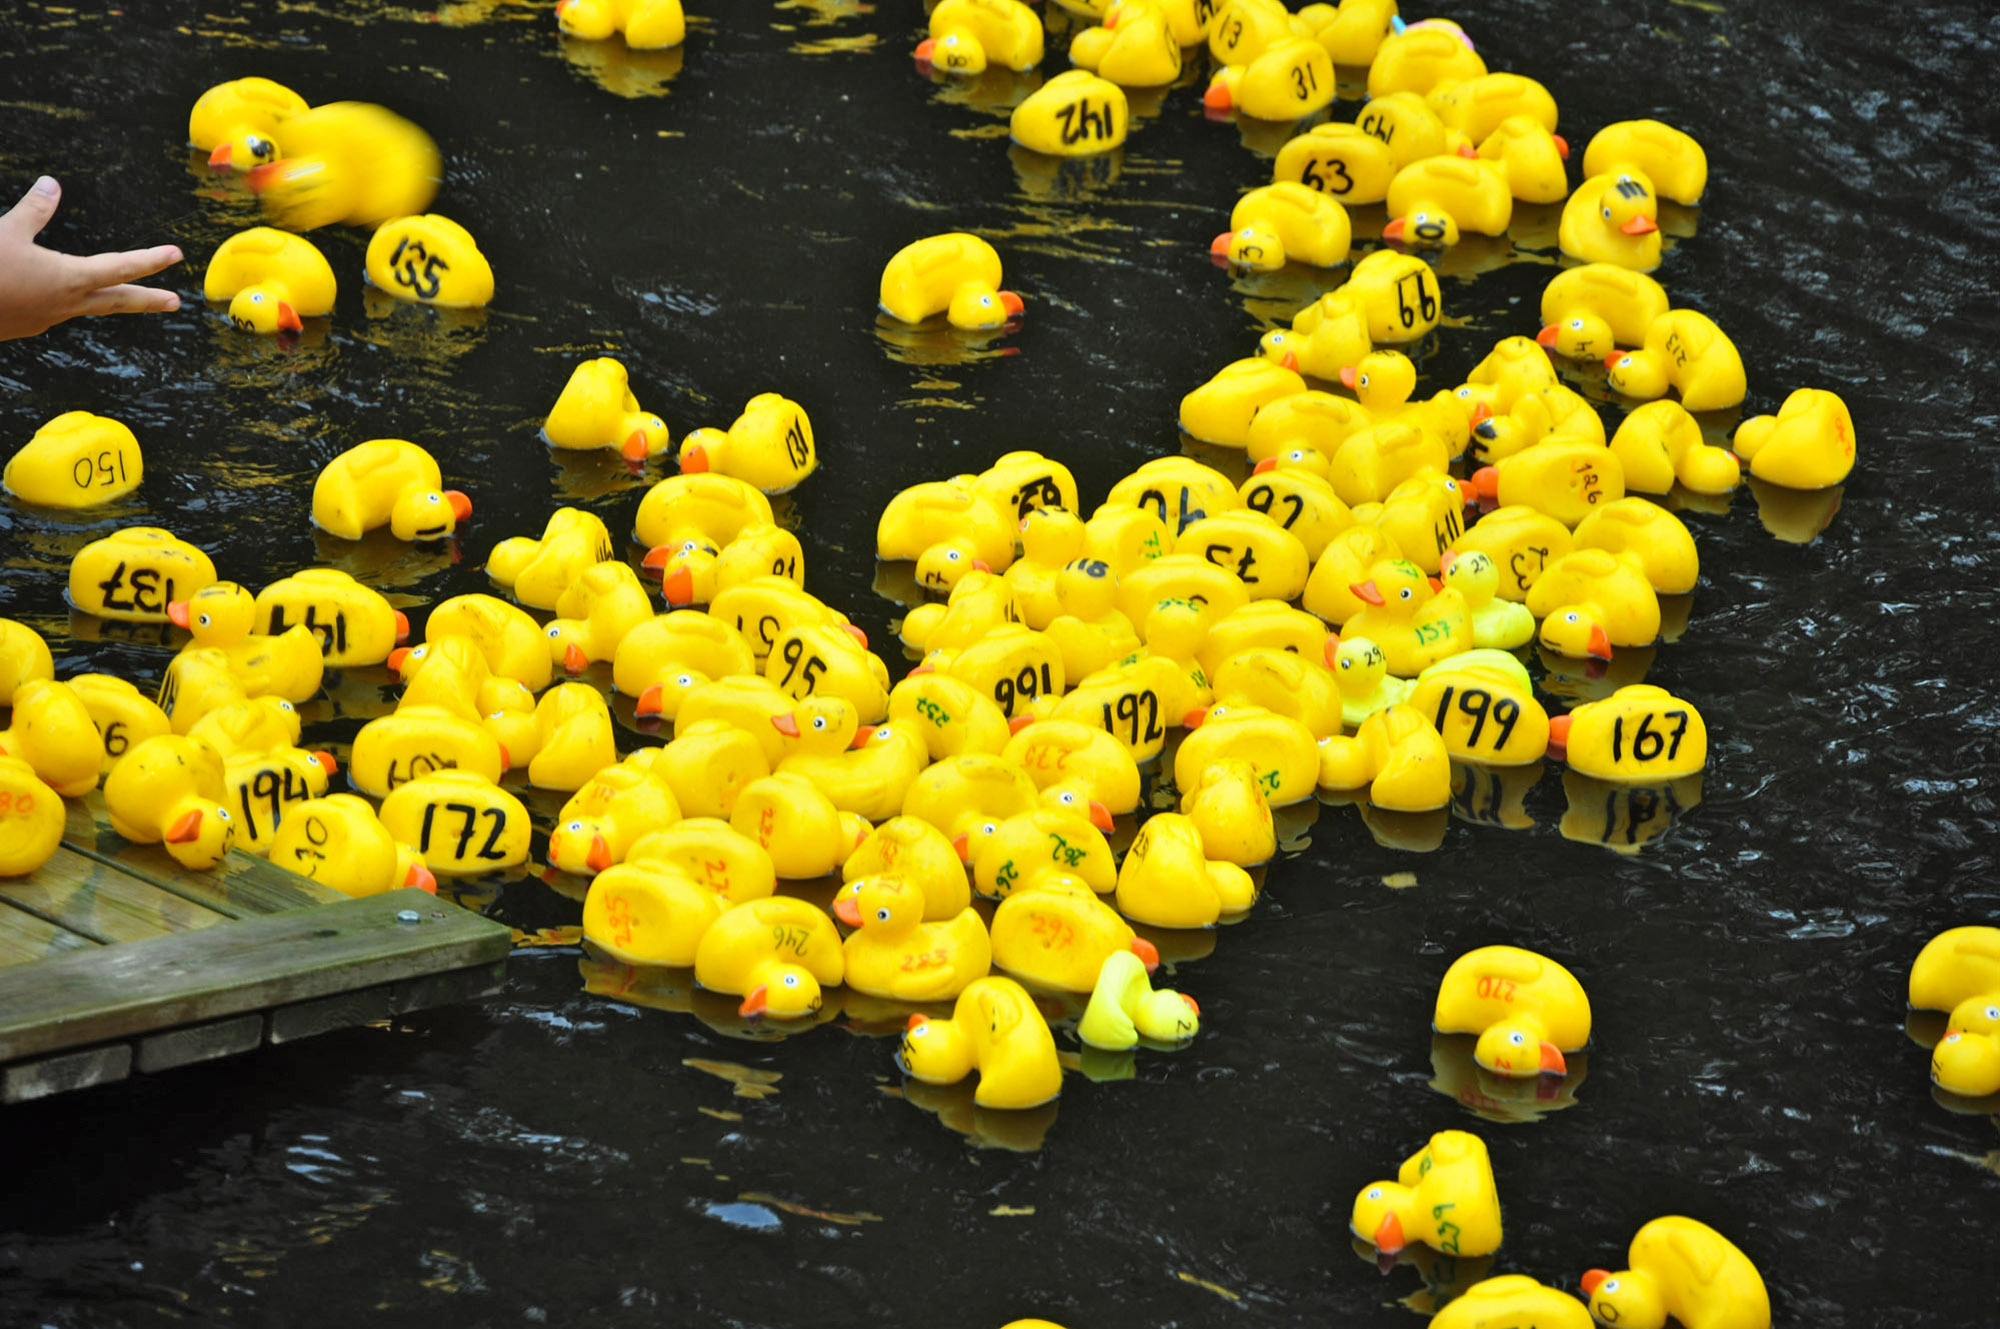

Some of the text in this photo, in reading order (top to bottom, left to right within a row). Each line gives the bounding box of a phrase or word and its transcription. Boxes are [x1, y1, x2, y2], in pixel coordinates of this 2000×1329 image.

[1301, 159, 1354, 195] 63
[73, 449, 126, 489] 150
[98, 560, 174, 615] 137
[1415, 620, 1451, 646] 157
[780, 637, 828, 700] 95
[1103, 689, 1163, 746] 192
[1434, 686, 1521, 751] 199
[1611, 709, 1689, 763] 167
[240, 766, 310, 841] 194
[420, 802, 507, 860] 172
